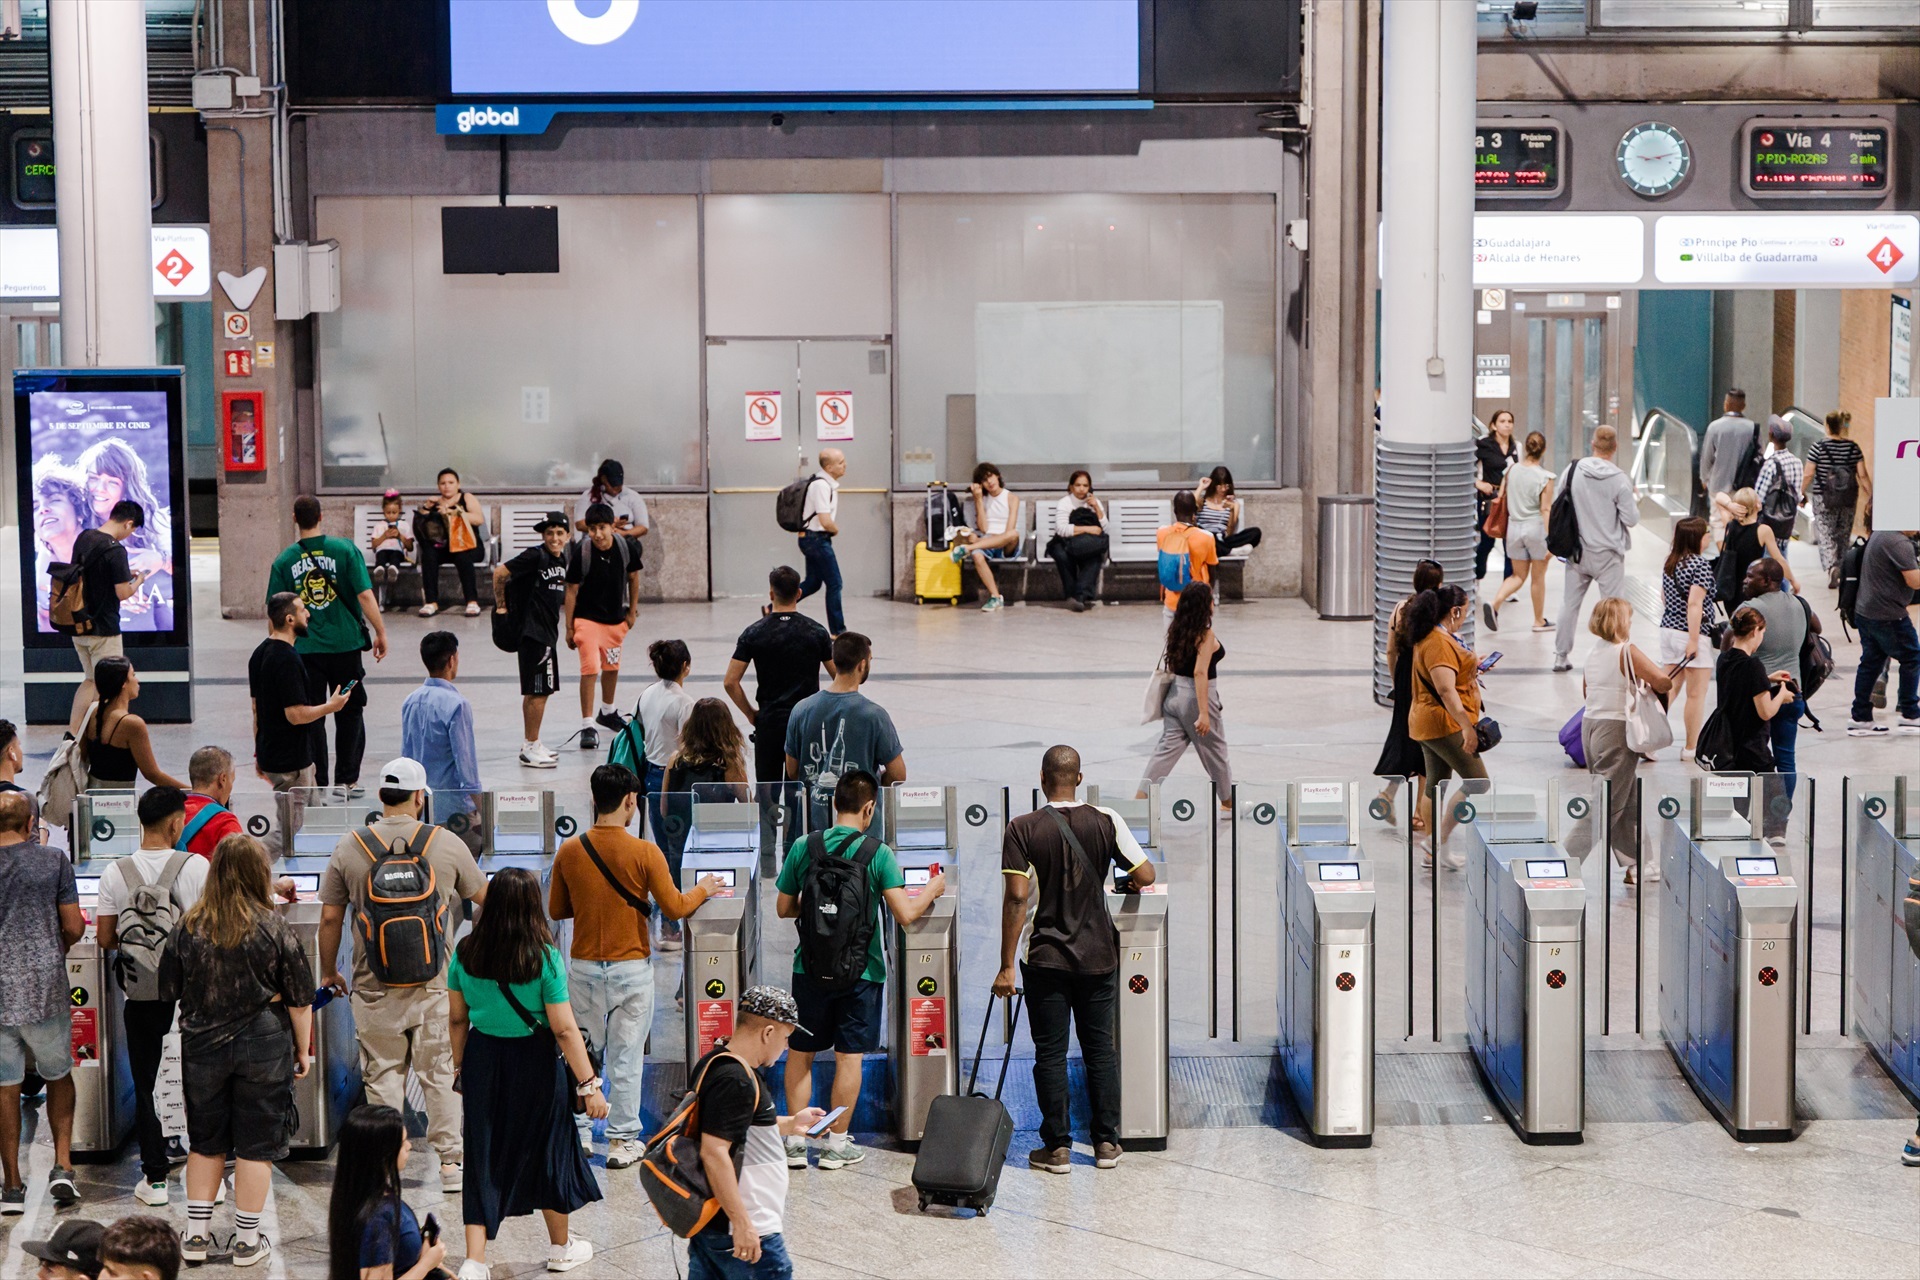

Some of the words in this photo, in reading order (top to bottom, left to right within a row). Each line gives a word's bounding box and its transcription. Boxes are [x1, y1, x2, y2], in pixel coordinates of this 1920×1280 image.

[456, 106, 520, 133] global
[1490, 132, 1503, 148] 3
[1820, 132, 1831, 148] 4
[1849, 153, 1859, 165] 2
[1859, 153, 1877, 165] min
[1489, 238, 1551, 250] Guadalajara
[1523, 253, 1536, 263] de
[1539, 253, 1581, 263] Henares
[1696, 252, 1736, 263] Villalba
[1739, 252, 1752, 263] de
[1755, 252, 1818, 263] Guadarrama
[1875, 243, 1893, 267] 4
[166, 256, 184, 280] 2
[116, 421, 127, 430] EN
[128, 421, 151, 430] CINES
[94, 800, 122, 808] PlayRenfe
[384, 871, 415, 881] BASIC-FIT
[1762, 941, 1776, 951] 20
[1131, 952, 1142, 960] 17
[1339, 950, 1351, 958] 18
[1550, 948, 1561, 956] 19
[708, 956, 719, 965] 15
[921, 954, 931, 963] 16
[70, 964, 82, 973] 12
